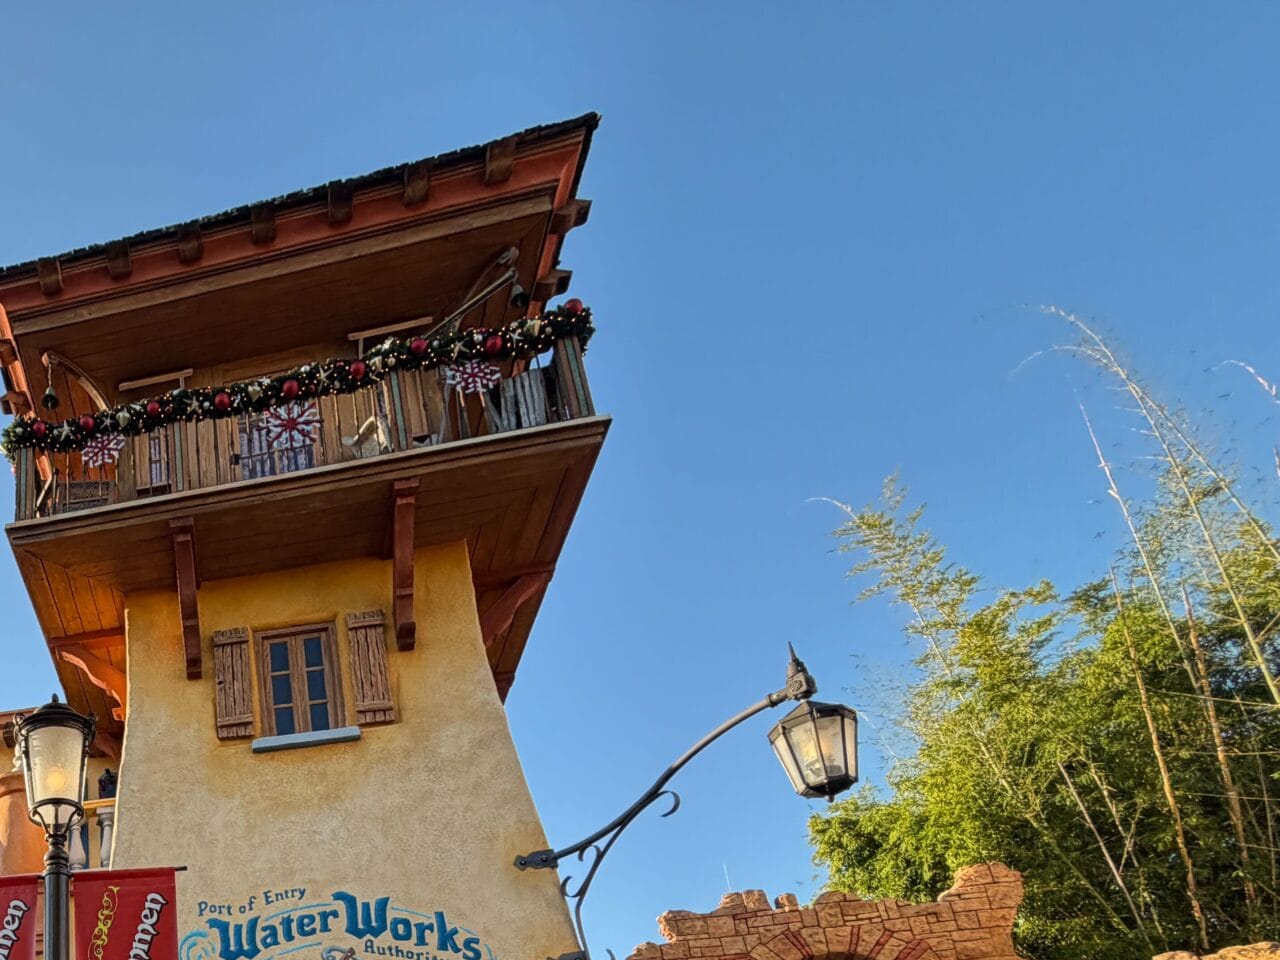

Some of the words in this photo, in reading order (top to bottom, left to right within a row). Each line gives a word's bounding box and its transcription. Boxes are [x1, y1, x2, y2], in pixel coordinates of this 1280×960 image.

[197, 901, 233, 917] Port
[238, 895, 258, 915] of
[263, 887, 307, 906] Entry
